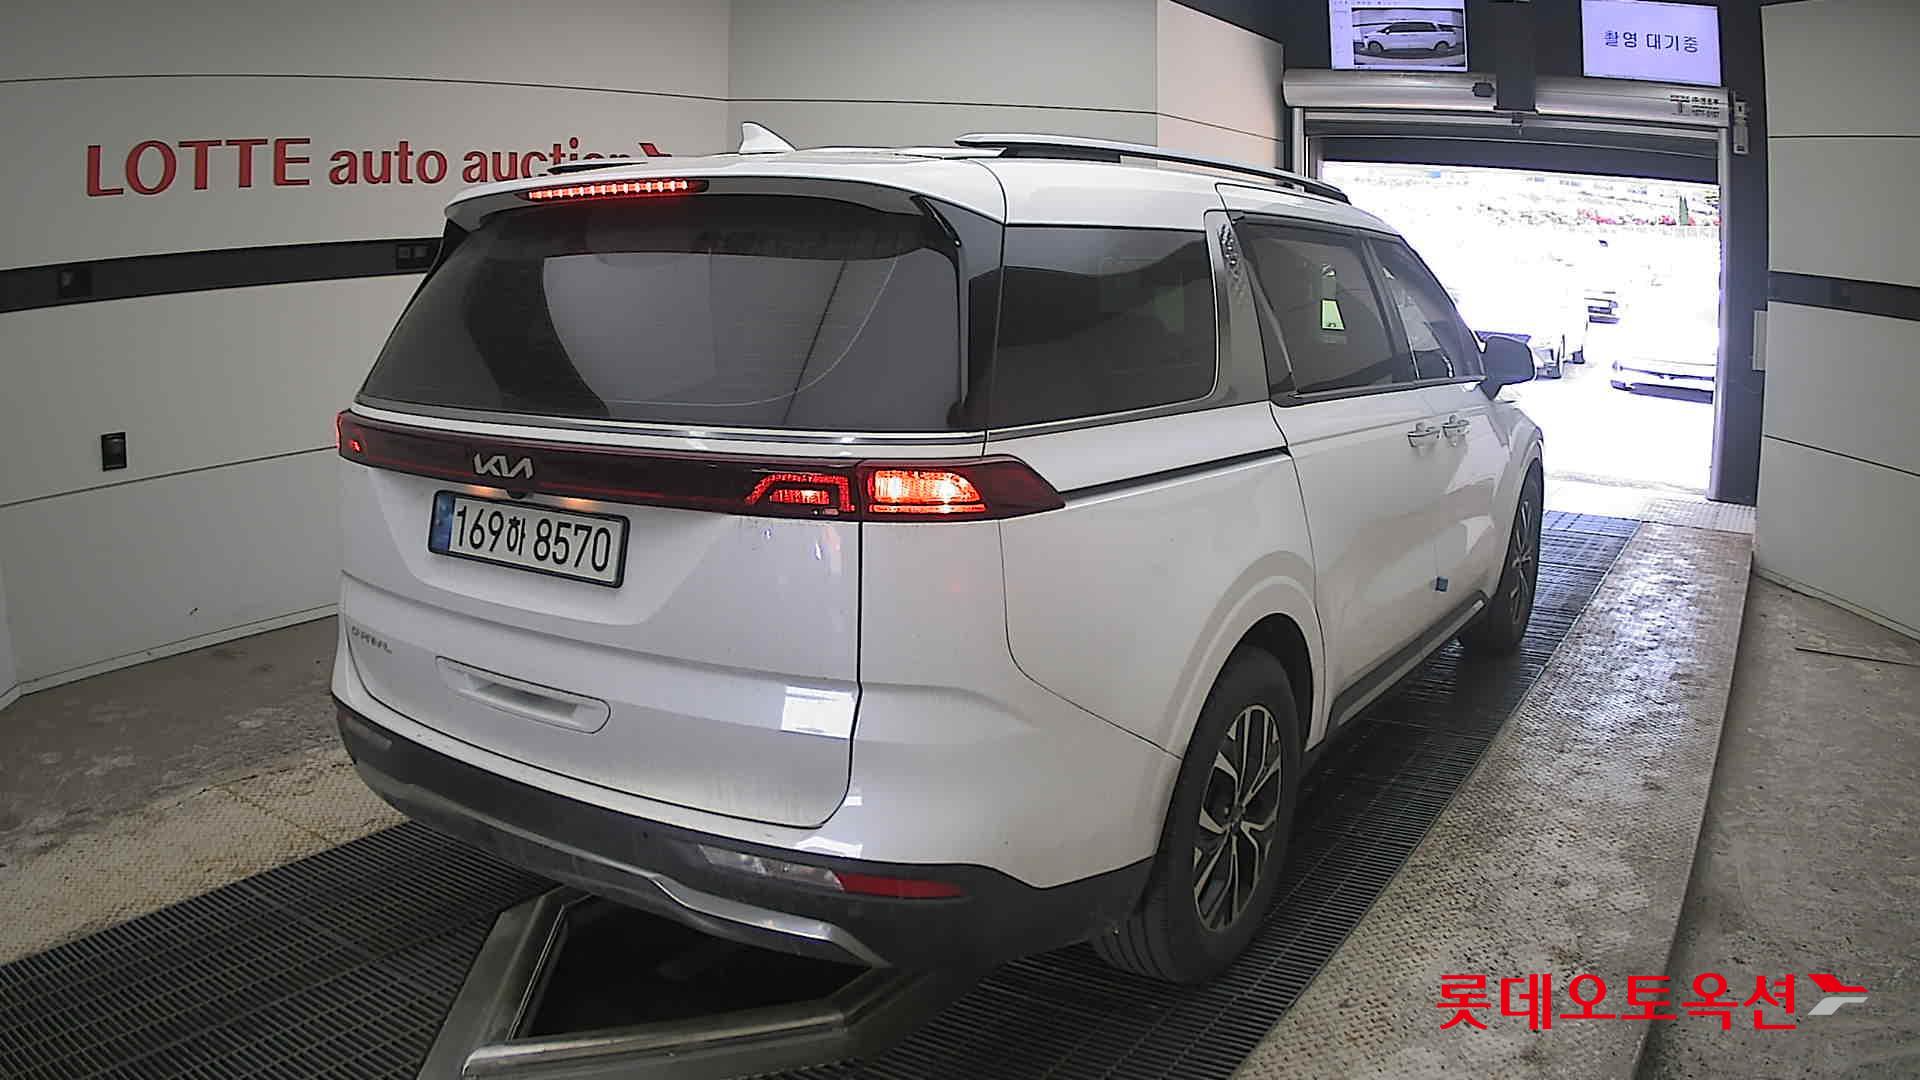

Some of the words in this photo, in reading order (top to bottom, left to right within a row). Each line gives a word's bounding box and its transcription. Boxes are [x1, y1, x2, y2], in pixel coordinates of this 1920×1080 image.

[1645, 32, 1699, 54] 대기중
[86, 137, 311, 197] LOTTE
[328, 140, 448, 185] auto
[473, 453, 536, 479] KIA
[456, 504, 527, 556] 169하
[533, 517, 612, 573] 8570
